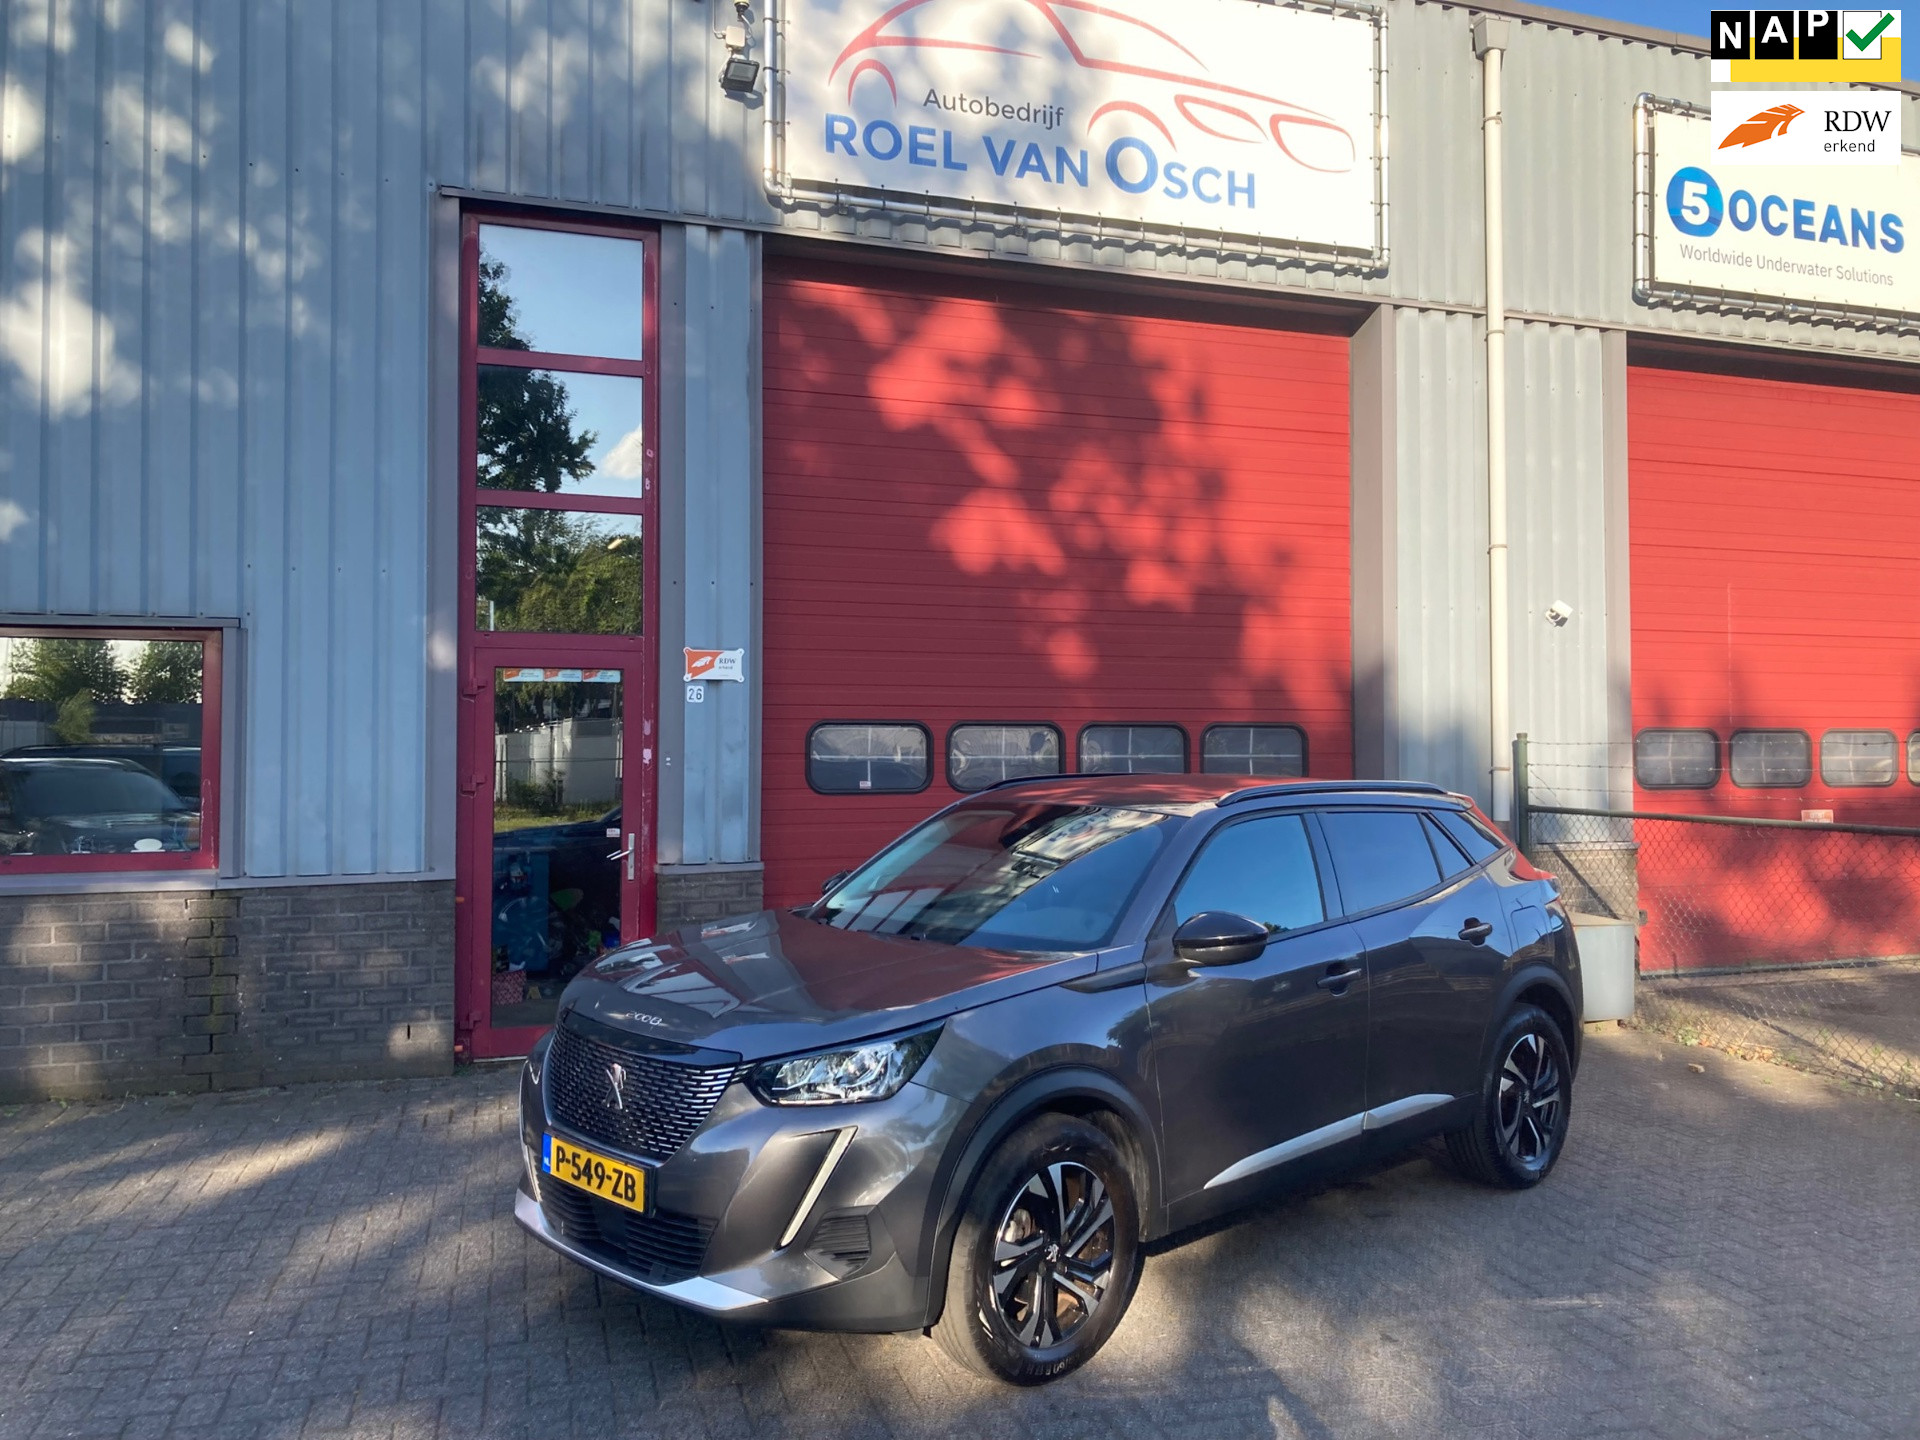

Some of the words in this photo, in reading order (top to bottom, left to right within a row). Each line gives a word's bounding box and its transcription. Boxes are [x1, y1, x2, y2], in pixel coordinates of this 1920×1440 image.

[923, 88, 1064, 131] Autobedrijf
[825, 113, 967, 172] ROEL
[982, 135, 1089, 188] VAN
[1728, 189, 1905, 254] OCEANS
[1680, 243, 1753, 268] Worldwide
[1756, 254, 1833, 278] Underwater
[1836, 264, 1894, 287] Solutions
[718, 657, 736, 665] RDW
[688, 688, 703, 701] 26
[555, 1145, 636, 1203] P-549-ZB
